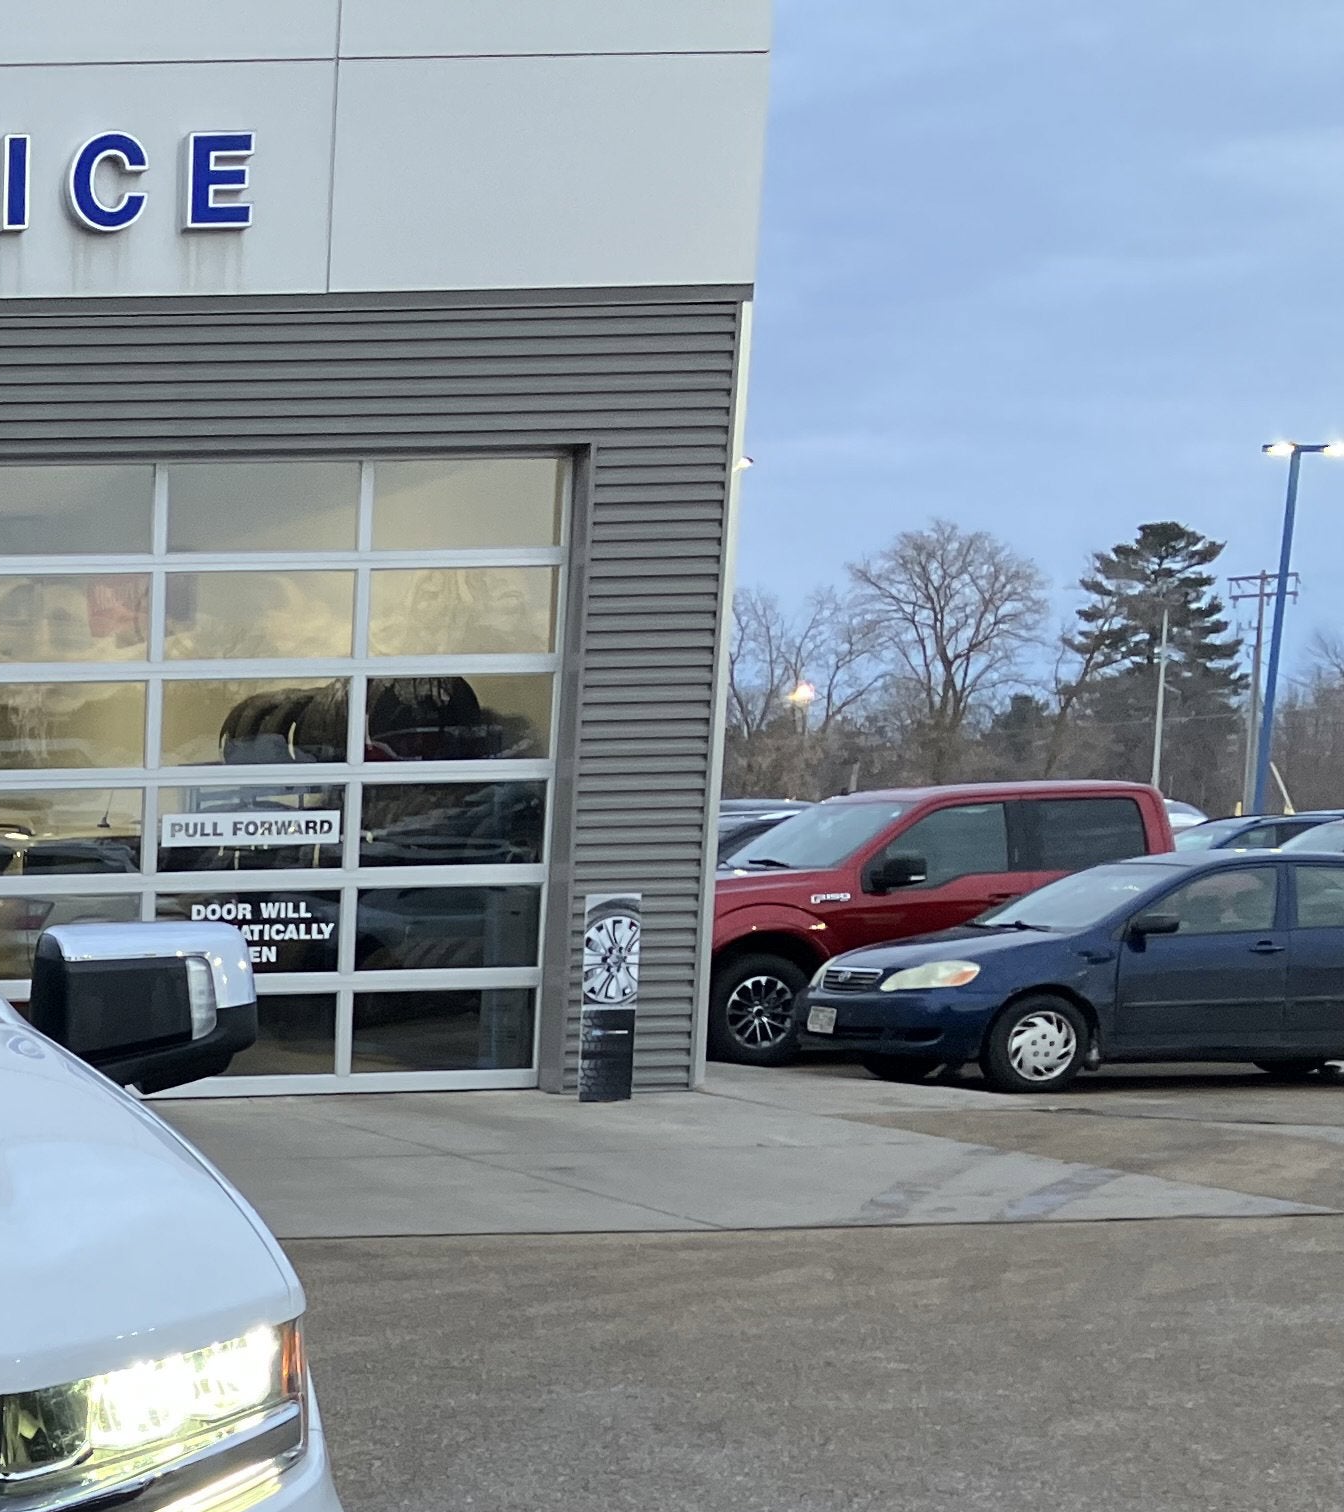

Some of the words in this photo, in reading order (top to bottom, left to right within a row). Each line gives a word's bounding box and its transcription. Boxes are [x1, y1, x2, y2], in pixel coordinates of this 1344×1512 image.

[169, 822, 224, 838] PULL
[232, 819, 333, 837] FORWARD
[191, 903, 252, 921] DOOR
[260, 902, 312, 919] WILL
[234, 922, 335, 941] ATICALLY
[250, 946, 277, 963] EN
